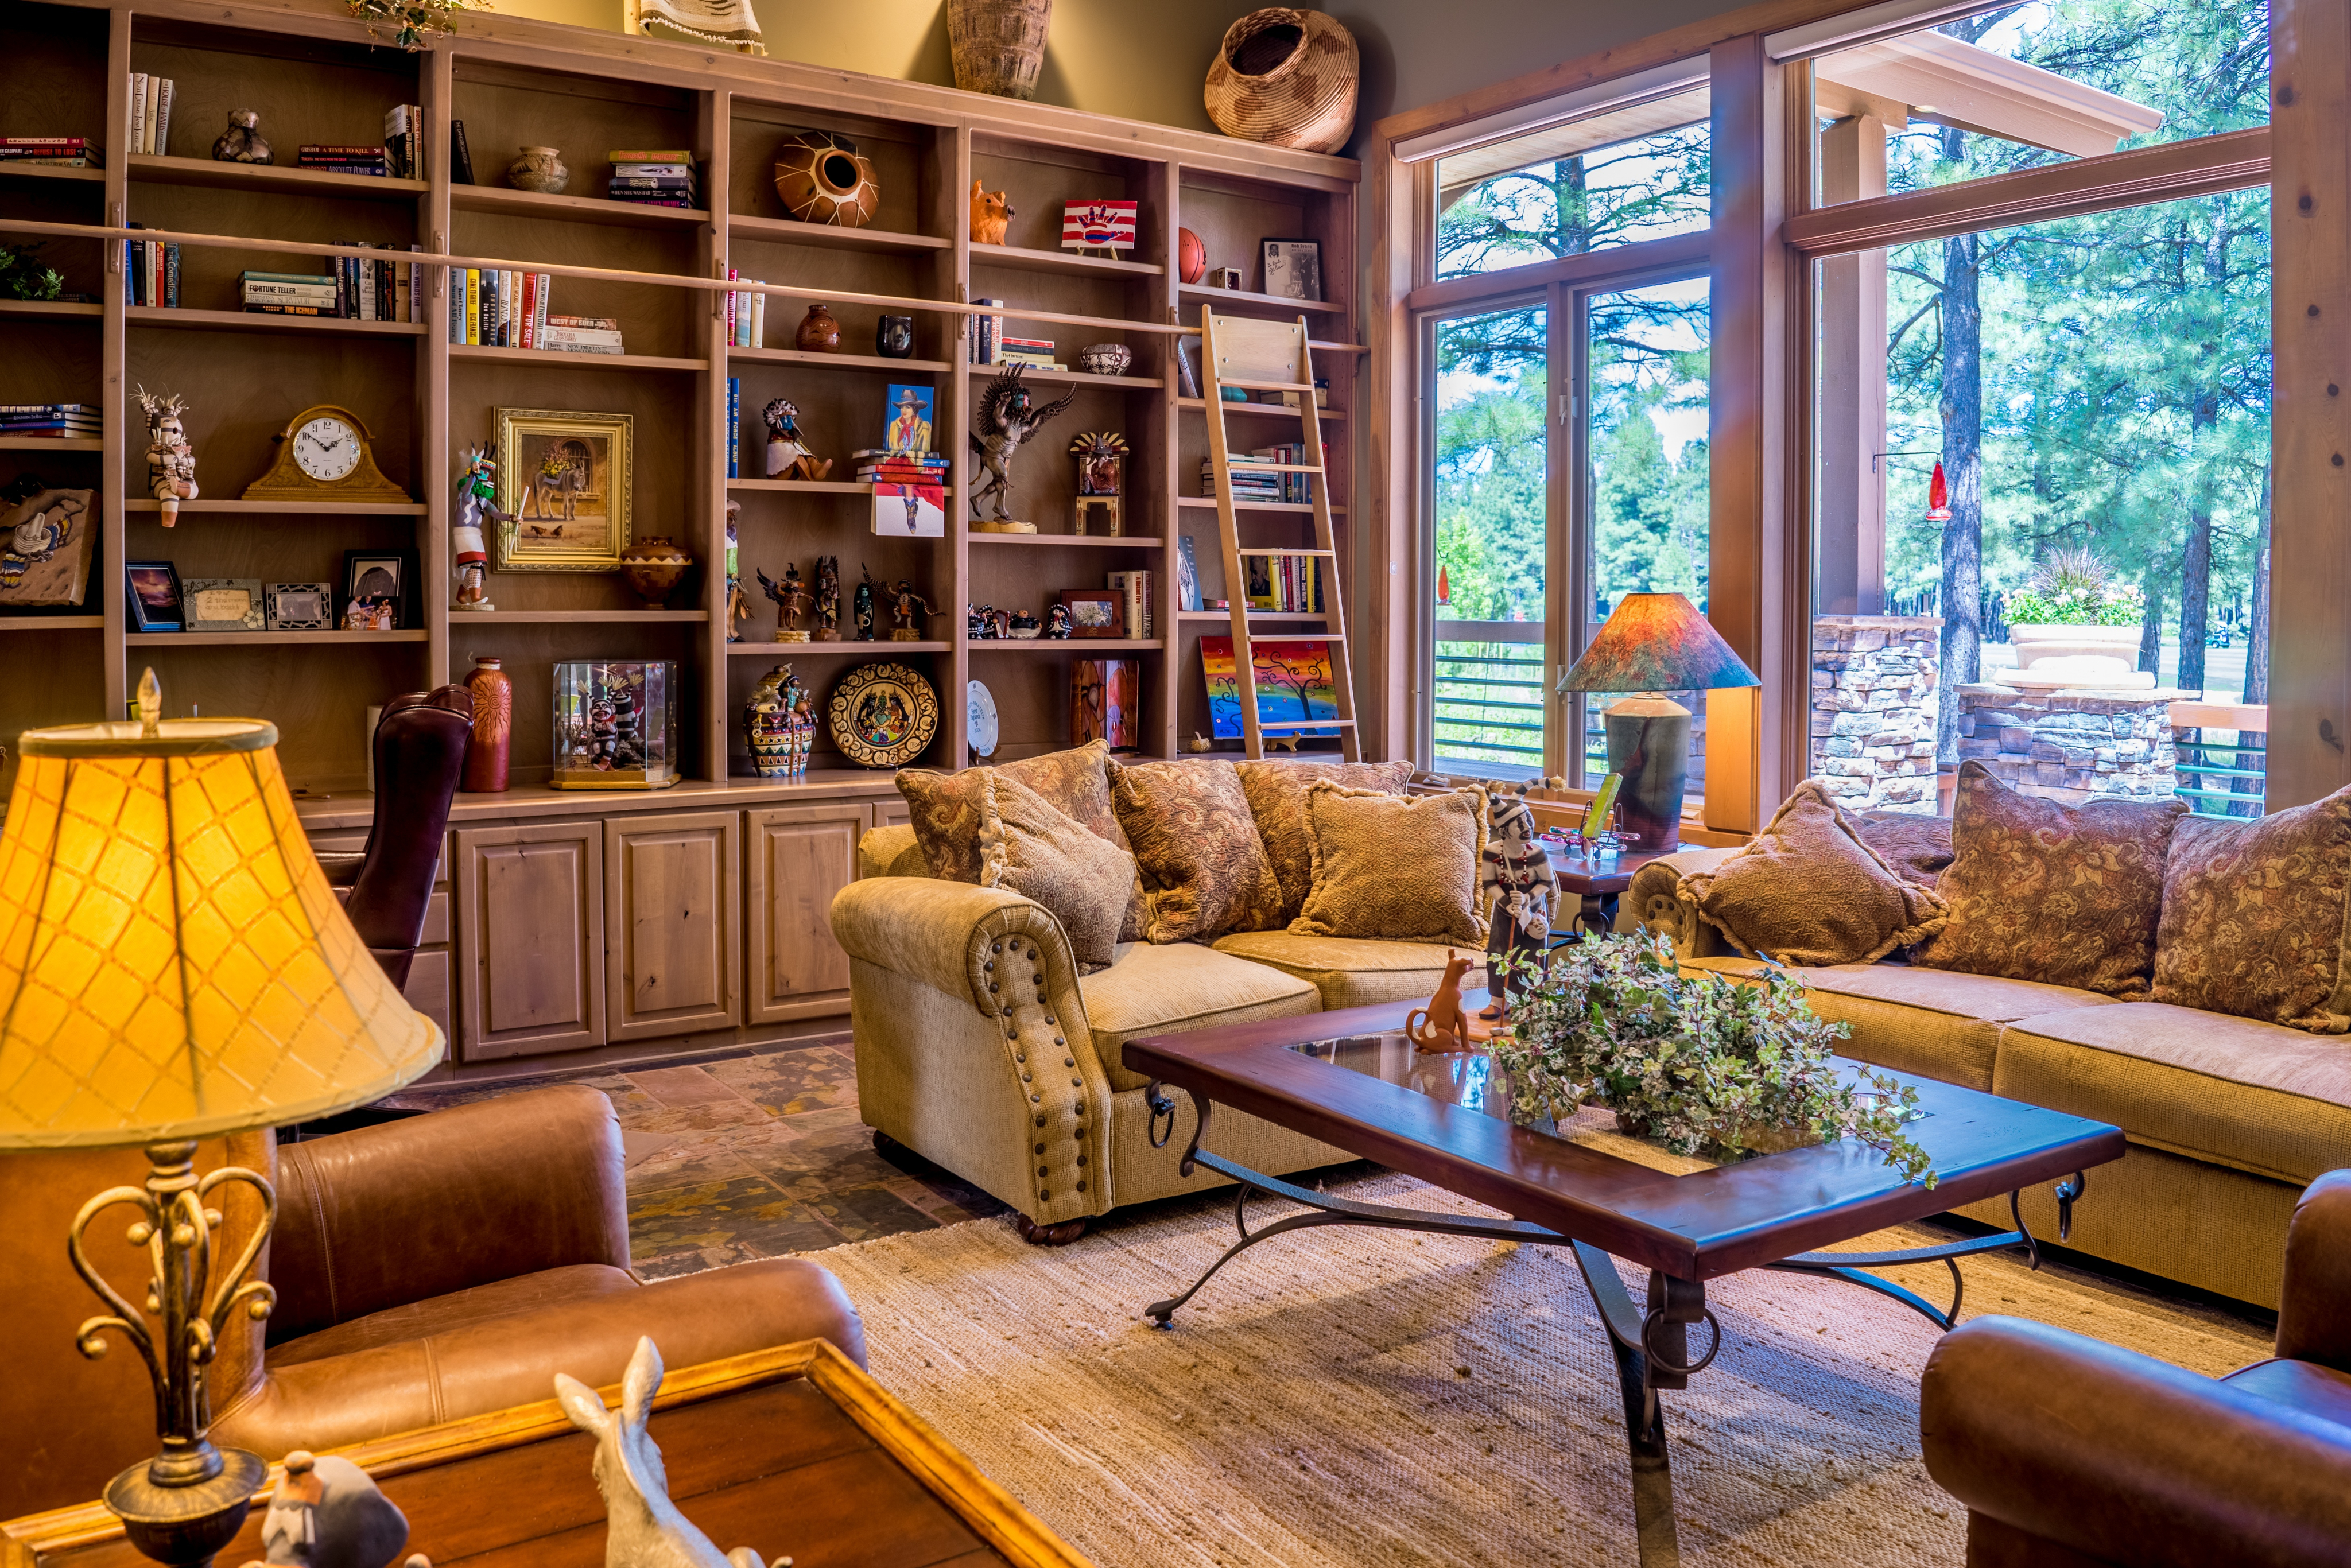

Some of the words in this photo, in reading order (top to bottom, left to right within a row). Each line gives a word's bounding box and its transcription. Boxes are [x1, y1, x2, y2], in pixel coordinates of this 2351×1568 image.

[161, 86, 169, 108] HOUSE
[135, 94, 143, 114] DREAMS
[160, 112, 168, 131] JANUS
[618, 150, 647, 160] Texasville
[354, 166, 371, 175] POWER
[167, 261, 176, 298] Comedians
[277, 286, 296, 294] TELLER
[277, 296, 310, 305] SURVIVOR
[285, 306, 295, 314] THE
[296, 306, 318, 315] ICEMAN
[728, 294, 736, 324] EVANOVICH
[525, 314, 533, 327] FOR
[312, 424, 317, 432] 11
[323, 421, 331, 430] 12
[338, 424, 340, 433] 1
[302, 432, 310, 440] 10
[346, 433, 352, 442] 2
[298, 444, 304, 453] 9
[302, 456, 309, 465] 8
[346, 457, 352, 465] 4
[312, 465, 318, 474] 7
[324, 468, 331, 477] 6
[337, 465, 343, 474] 5
[1143, 614, 1152, 631] TRACE
